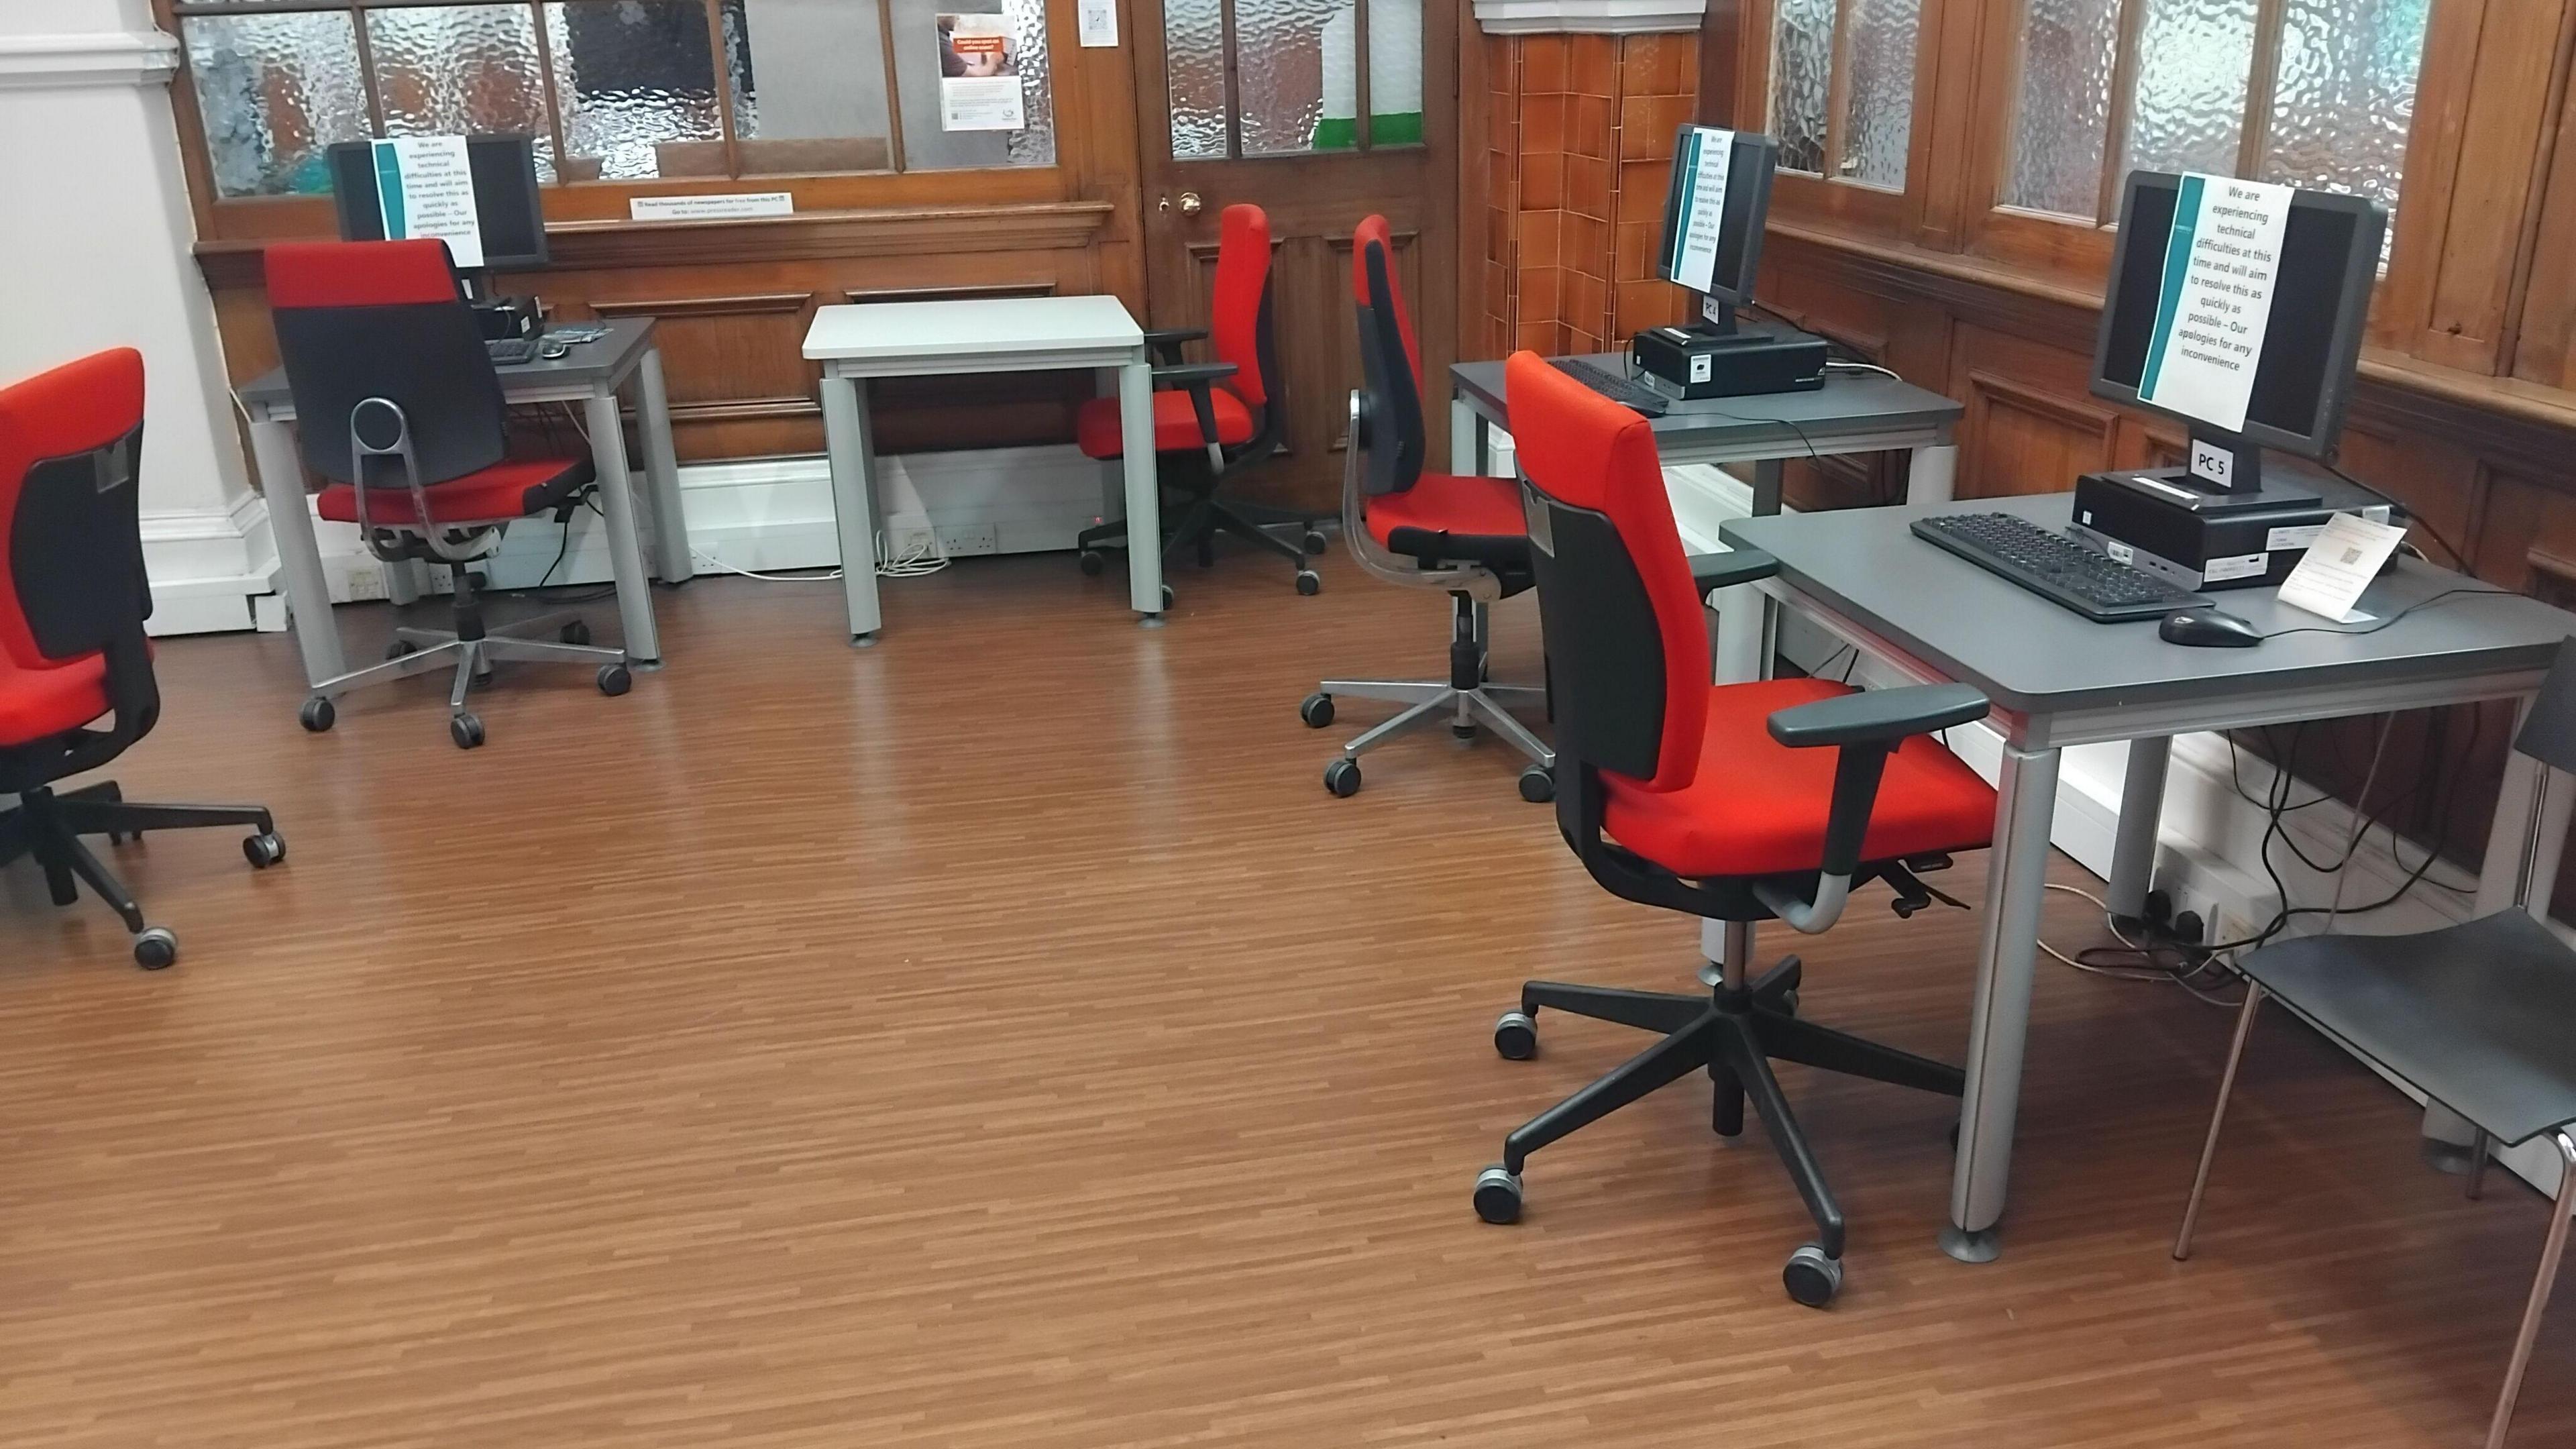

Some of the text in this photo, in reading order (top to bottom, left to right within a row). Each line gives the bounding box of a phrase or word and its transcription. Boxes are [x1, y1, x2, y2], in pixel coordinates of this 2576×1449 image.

[409, 151, 455, 159] experiencing
[2229, 186, 2260, 201] We are
[413, 221, 447, 229] apologies
[417, 211, 446, 219] possible
[2212, 205, 2269, 225] experiencing
[2217, 224, 2255, 239] technical
[2196, 237, 2271, 262] difficulties at this
[2194, 256, 2267, 281] time and will aim
[2191, 275, 2262, 299] to resolve this as
[2200, 297, 2241, 314] quickly as
[2188, 313, 2222, 328] possible
[2231, 321, 2248, 334] Our
[2178, 329, 2253, 357] apologies for any
[2182, 345, 2240, 371] inconvenience
[2199, 453, 2224, 475] PC 5
